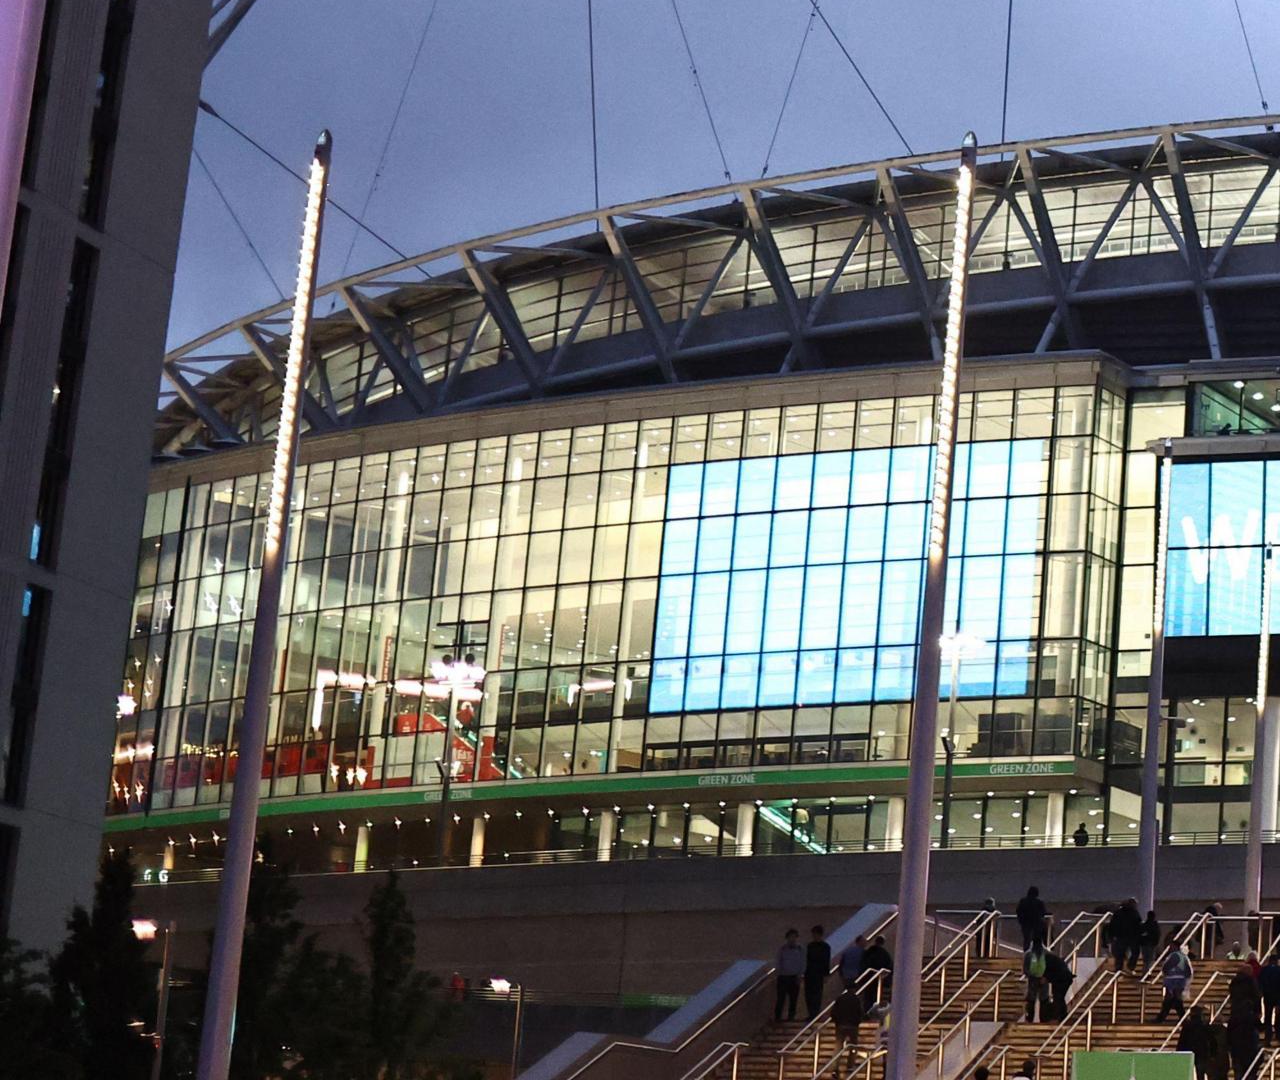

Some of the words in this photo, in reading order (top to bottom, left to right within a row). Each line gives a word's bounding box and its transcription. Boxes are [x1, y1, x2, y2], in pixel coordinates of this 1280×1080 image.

[990, 764, 1024, 775] GREEN
[1026, 763, 1054, 774] ZONE
[697, 775, 729, 786] GREEN
[730, 774, 756, 785] ZONE
